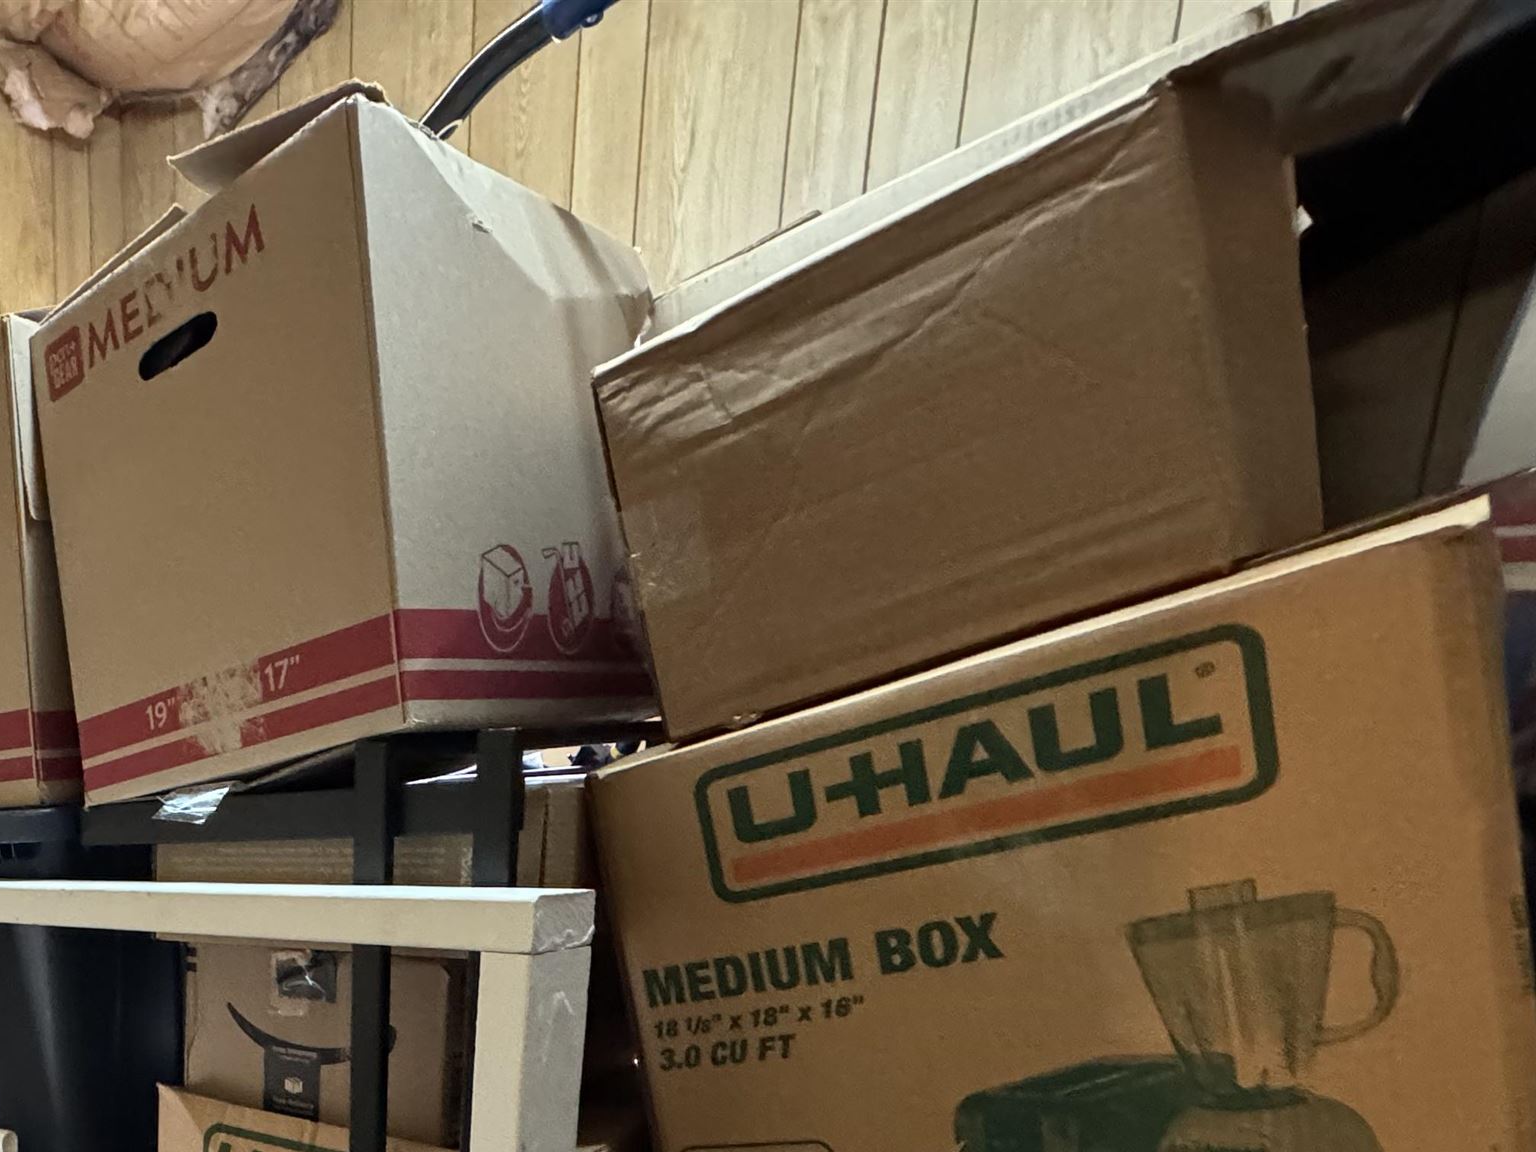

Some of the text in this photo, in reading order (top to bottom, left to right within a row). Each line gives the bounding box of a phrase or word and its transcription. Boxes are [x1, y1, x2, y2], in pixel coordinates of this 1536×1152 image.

[264, 655, 300, 692] 17"
[726, 672, 1224, 844] U-HAUL
[642, 912, 1006, 1008] MEDIUM BOX
[653, 1018, 678, 1040] 18
[729, 1014, 743, 1030] x
[752, 1004, 790, 1029] 18"
[797, 1005, 813, 1023] x
[659, 1033, 797, 1072] 3.0 CU FT
